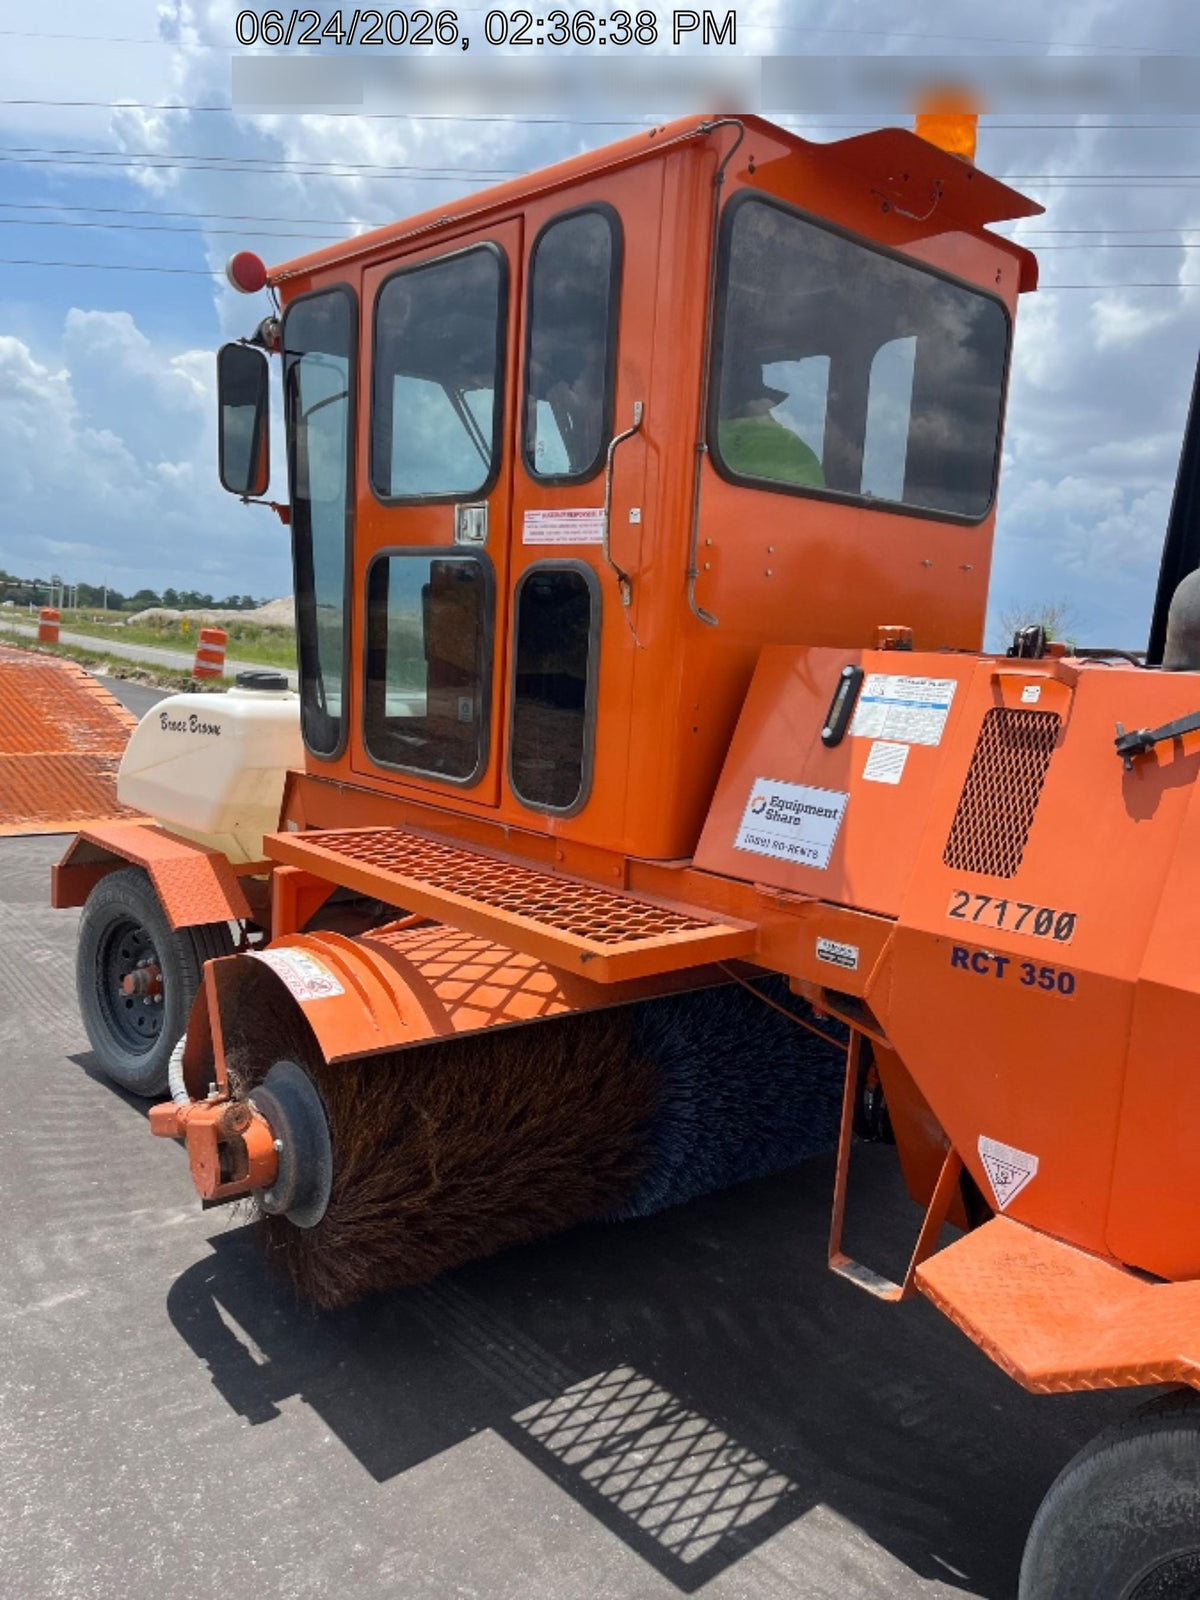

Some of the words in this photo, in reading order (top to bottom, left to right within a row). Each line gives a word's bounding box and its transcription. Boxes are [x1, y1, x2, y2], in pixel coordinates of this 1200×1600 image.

[765, 808, 801, 826] Share
[770, 796, 839, 820] Equipment
[949, 890, 1077, 941] 271700
[951, 947, 1010, 978] RCT
[1020, 963, 1075, 995] 350
